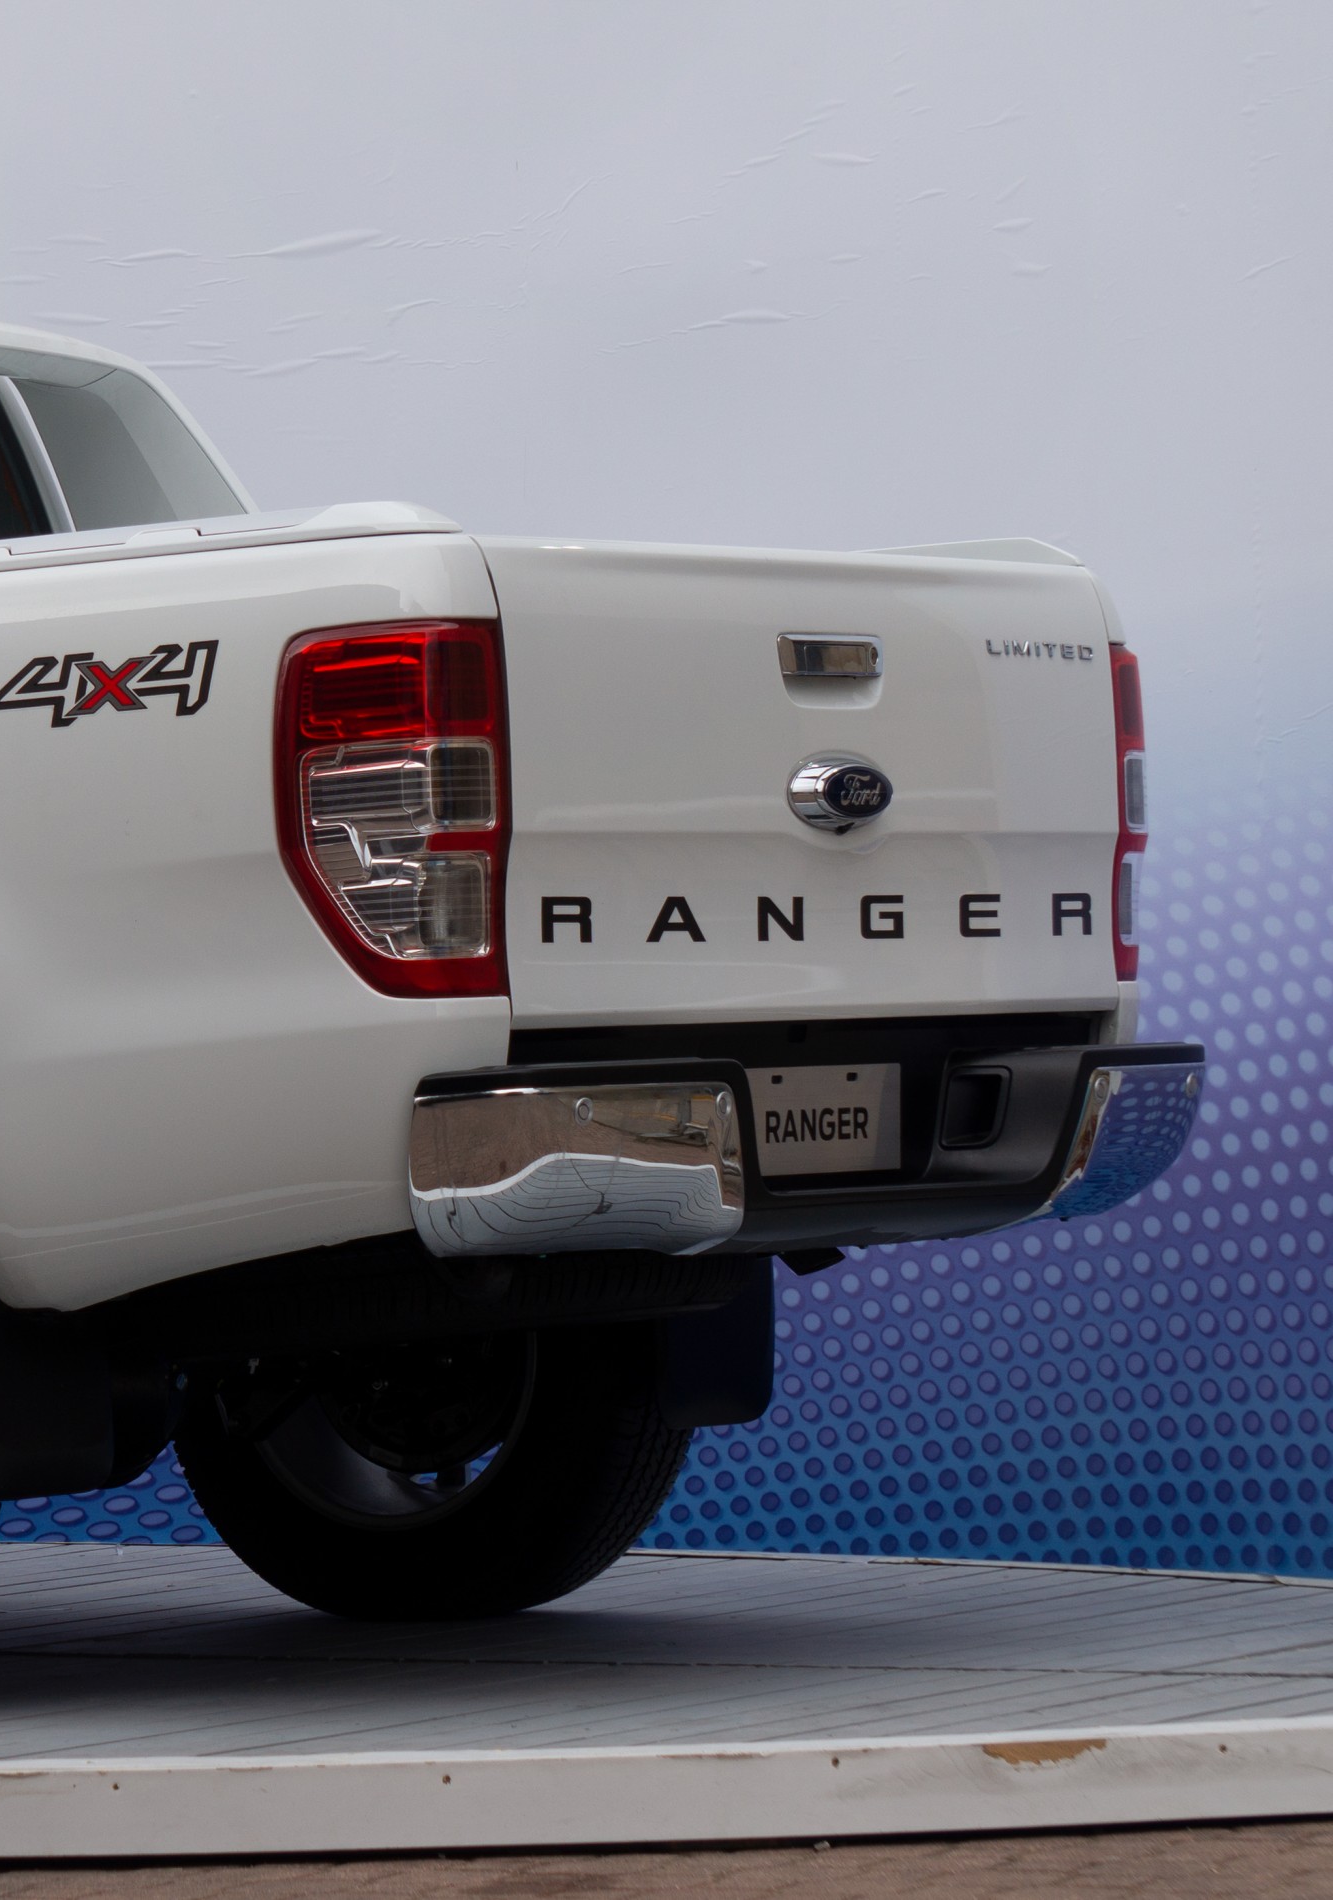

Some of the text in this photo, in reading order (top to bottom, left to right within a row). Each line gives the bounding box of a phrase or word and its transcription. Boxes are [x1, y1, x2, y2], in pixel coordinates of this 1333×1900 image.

[985, 639, 1093, 661] LIMITED
[840, 773, 882, 806] Ford
[540, 893, 1093, 943] RANGER
[765, 1107, 868, 1143] RANGER
